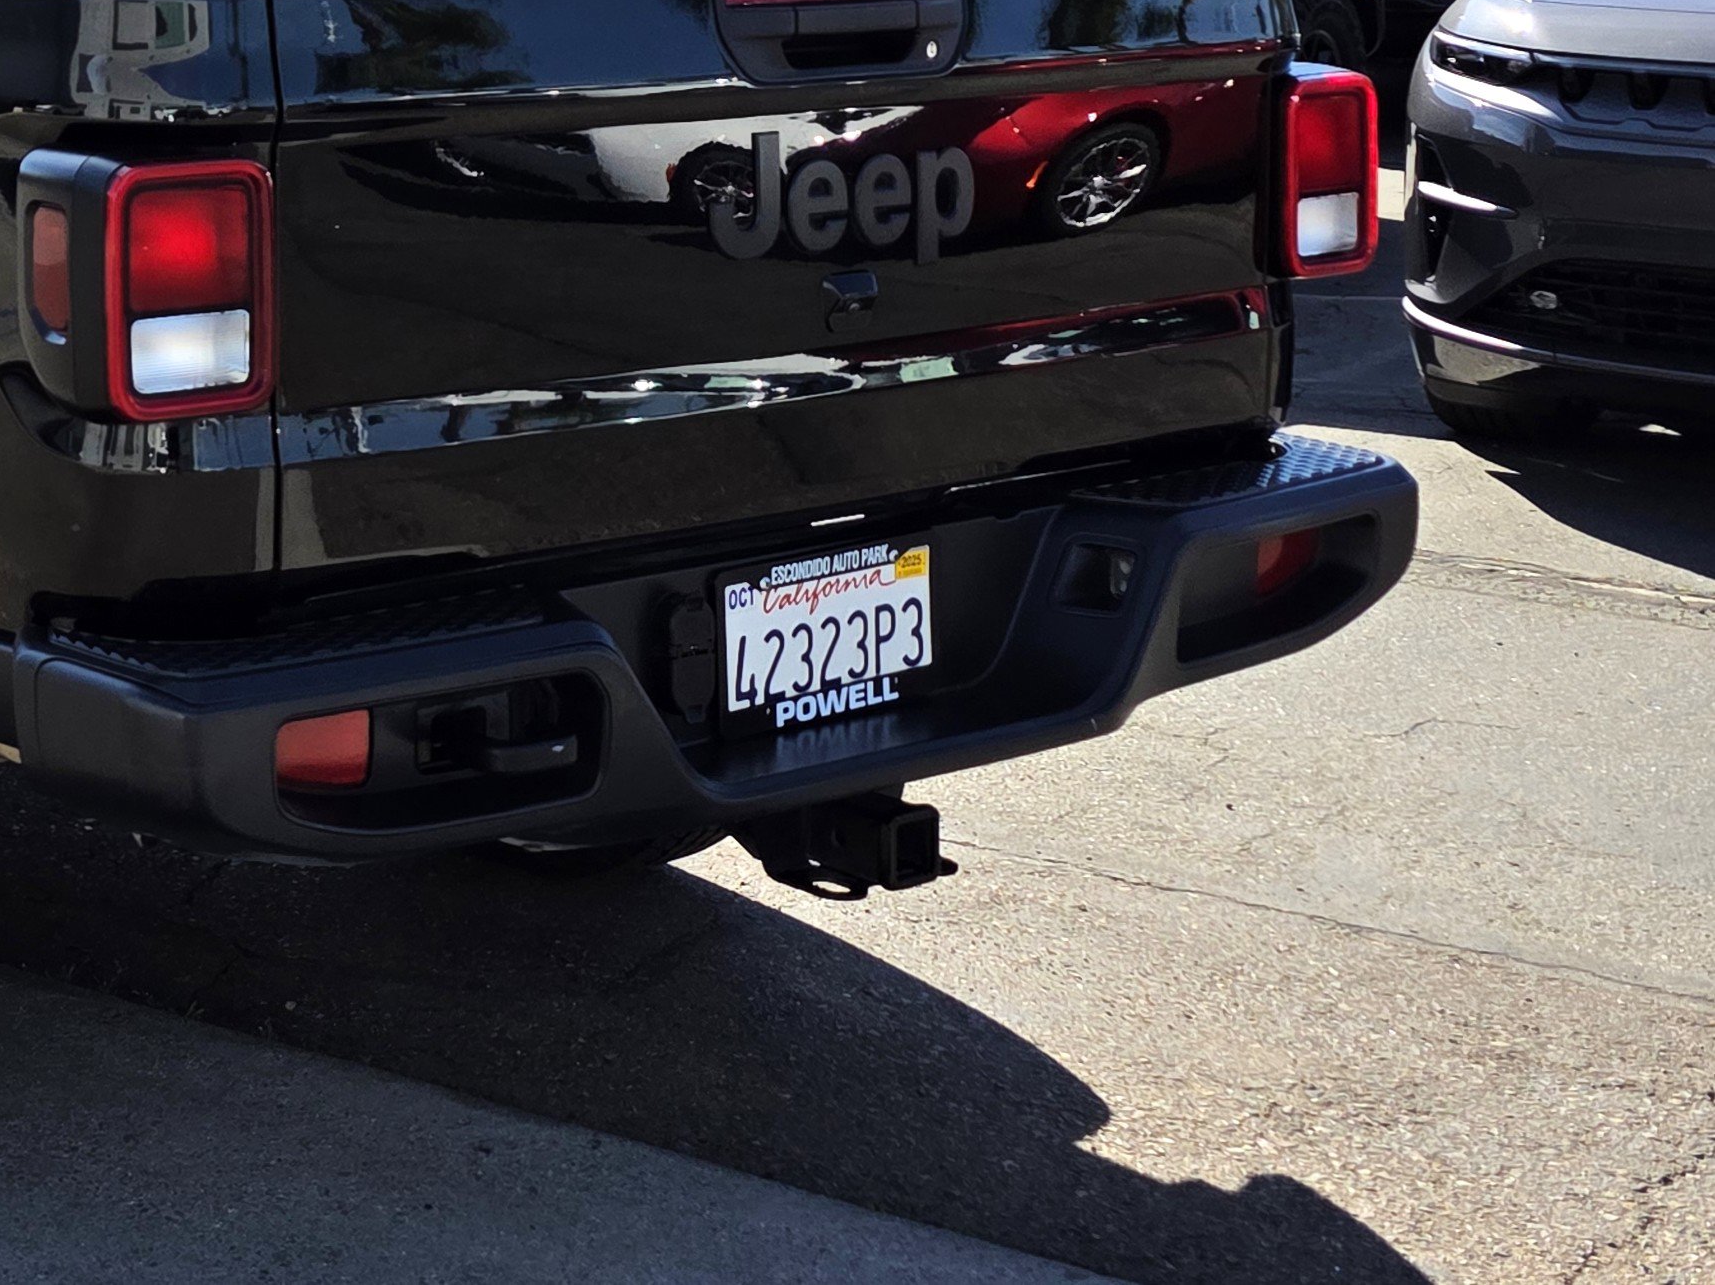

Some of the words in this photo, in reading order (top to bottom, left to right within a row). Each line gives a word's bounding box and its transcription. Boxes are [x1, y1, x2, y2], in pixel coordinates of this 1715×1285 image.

[709, 131, 975, 264] Jeep
[772, 555, 830, 586] ESCONDIDO
[833, 549, 859, 573] AUTO
[861, 544, 889, 568] PARK
[901, 554, 922, 568] 2025
[728, 585, 755, 610] OCT
[760, 569, 896, 615] California
[735, 597, 923, 704] 42323P3
[776, 677, 899, 728] POWELL
